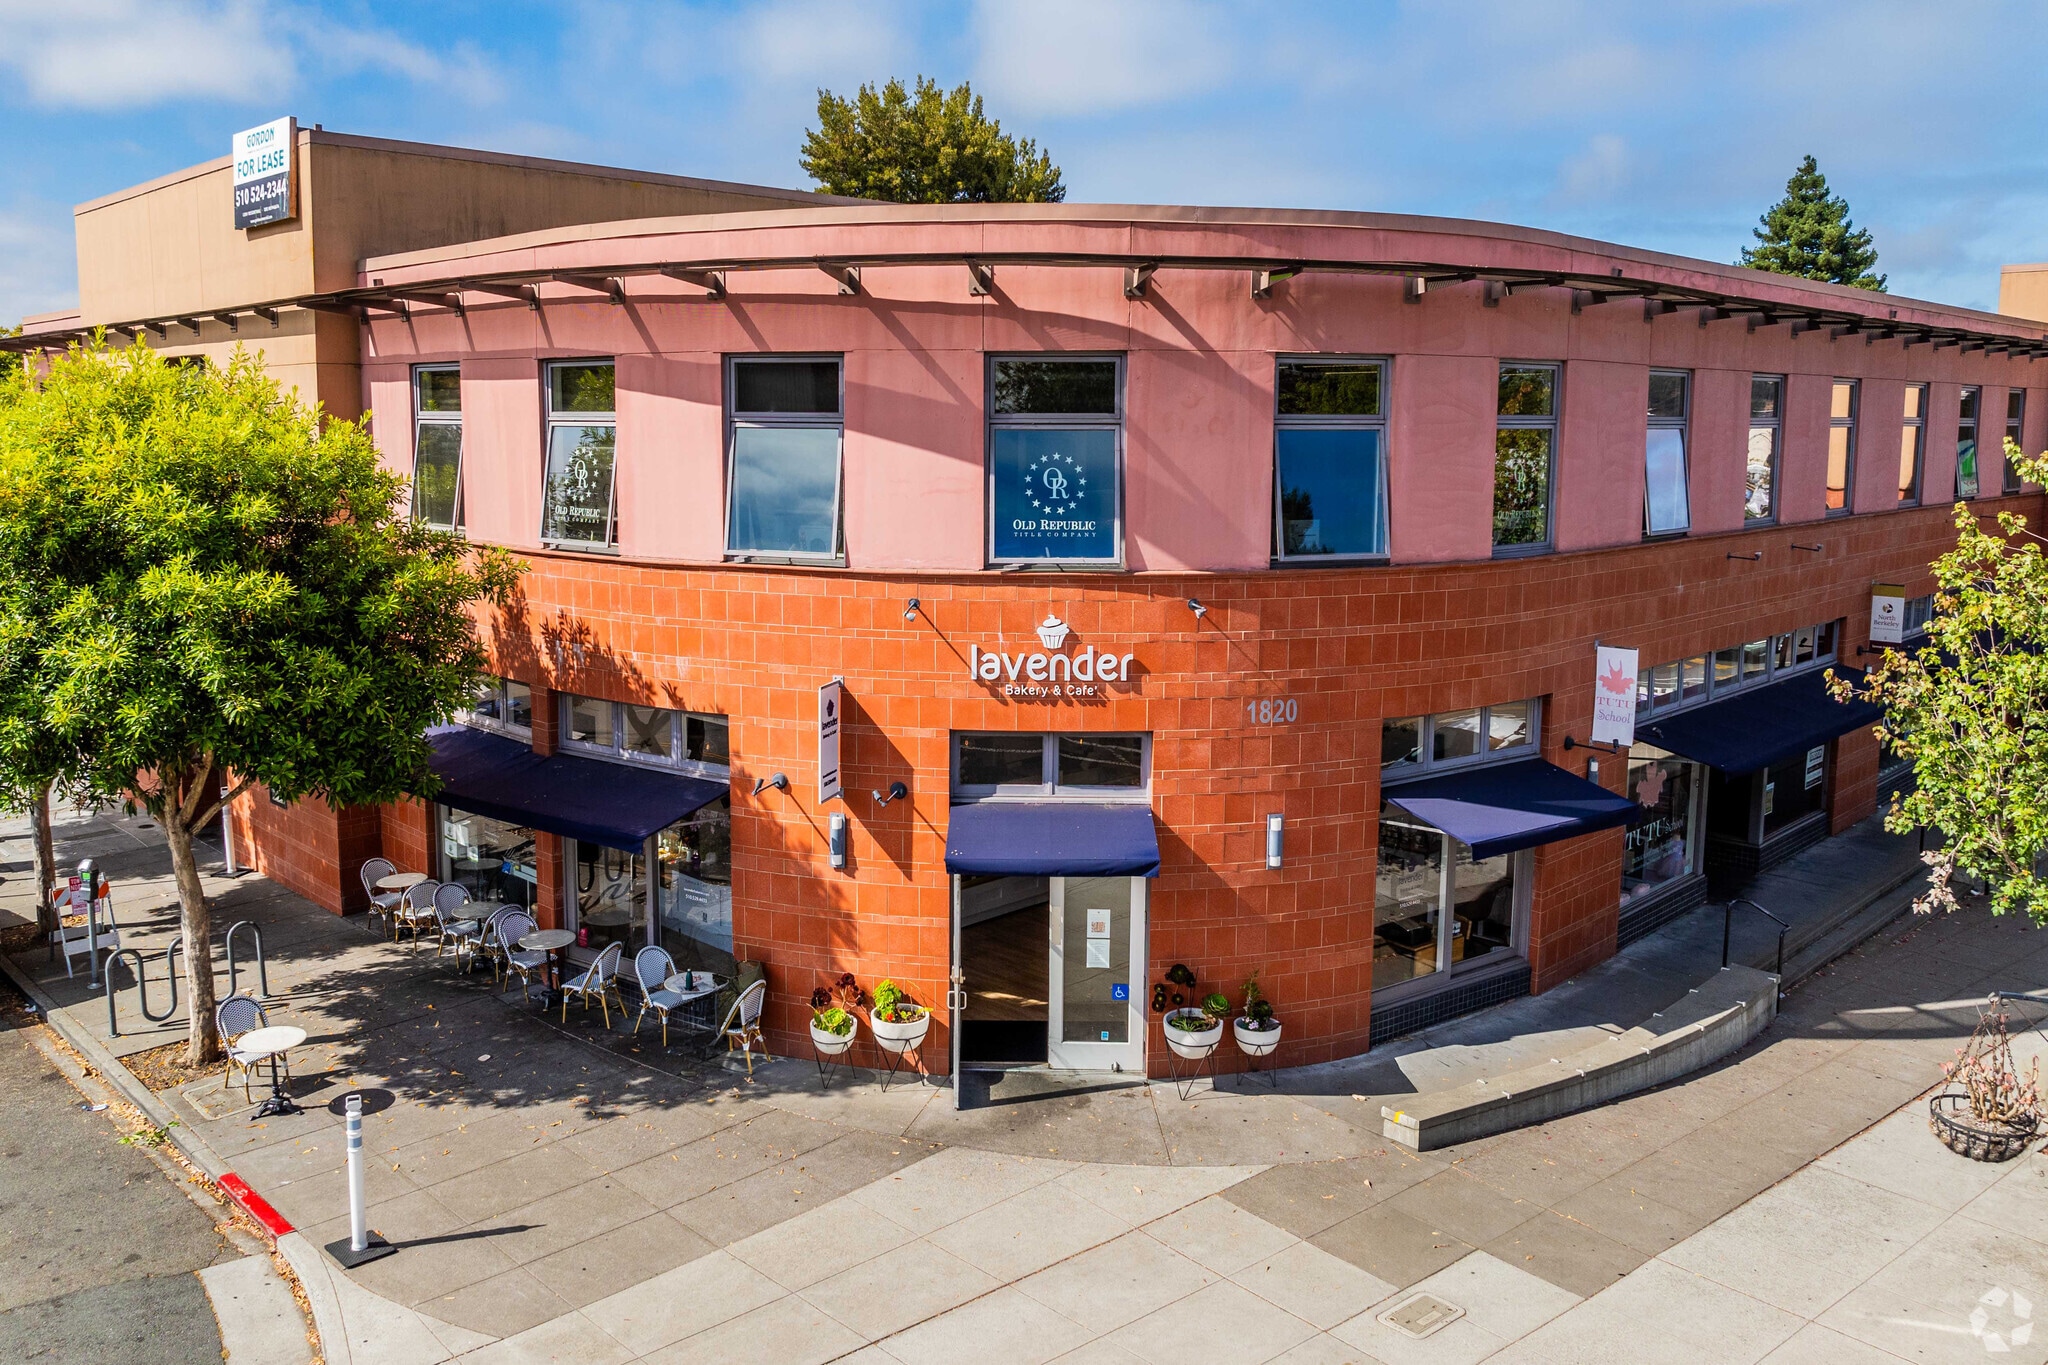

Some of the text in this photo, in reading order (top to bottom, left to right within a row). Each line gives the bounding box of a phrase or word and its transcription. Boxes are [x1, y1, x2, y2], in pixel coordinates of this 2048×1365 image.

[246, 127, 274, 148] GORDON
[238, 150, 284, 178] FOR LEASE
[236, 178, 286, 207] 510 524-2344
[569, 506, 601, 518] REPUBLIC
[1013, 519, 1096, 531] OLD REPUBLIC
[971, 644, 1133, 682] lavender
[1005, 684, 1049, 697] Bakery
[1053, 686, 1062, 696] &
[1247, 699, 1298, 724] 1820
[1596, 696, 1634, 709] TUTU
[822, 716, 838, 732] lavender
[1597, 709, 1631, 724] School
[1626, 817, 1666, 851] TUTU
